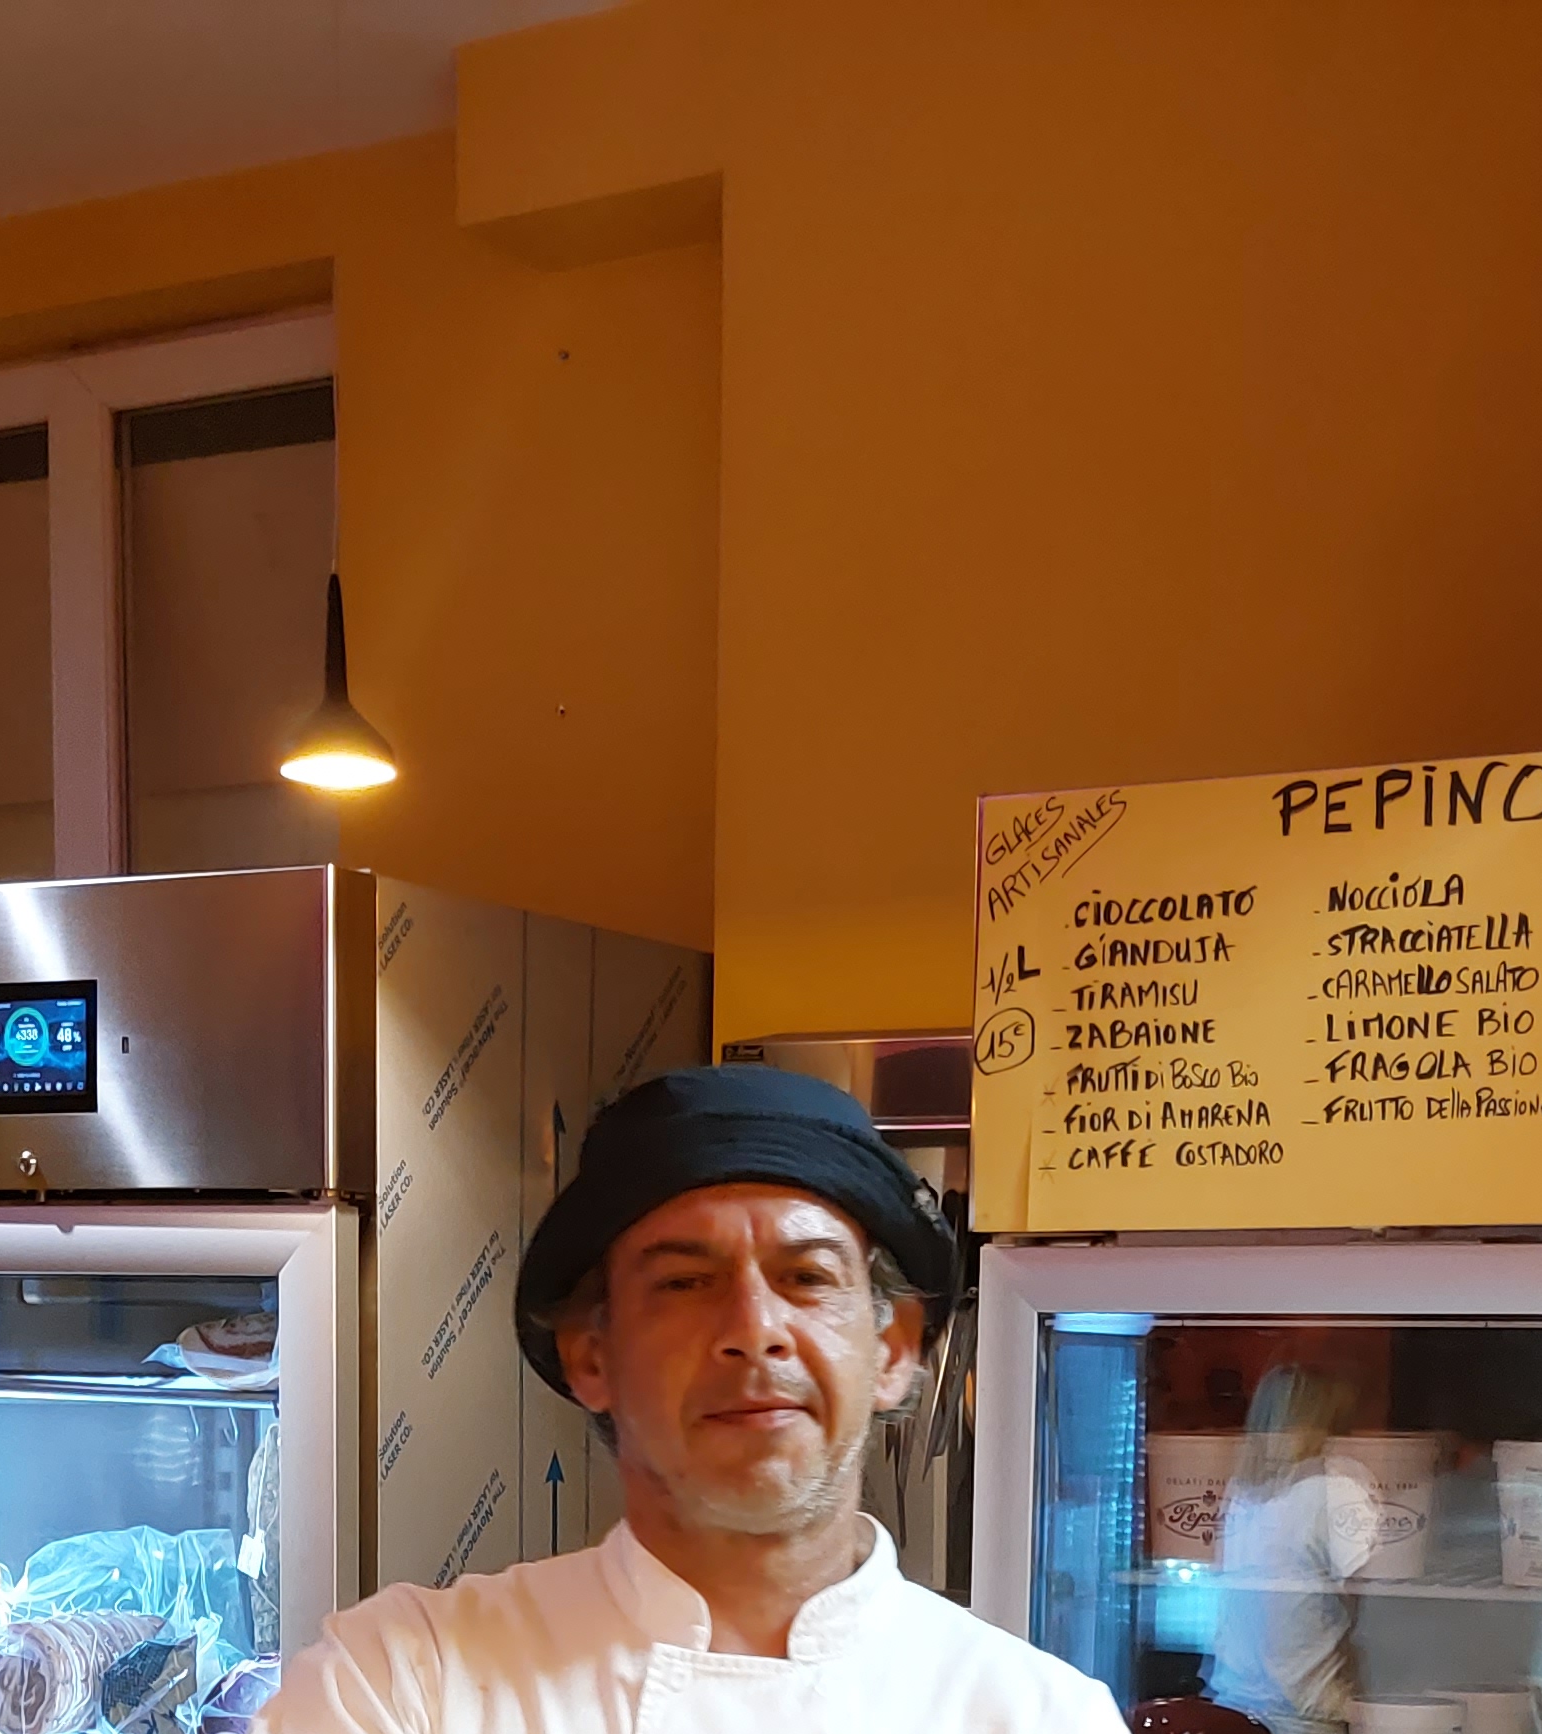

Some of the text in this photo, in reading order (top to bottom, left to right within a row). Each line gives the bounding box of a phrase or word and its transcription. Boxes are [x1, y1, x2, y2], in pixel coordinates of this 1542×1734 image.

[985, 796, 1064, 865] GLACES
[1018, 945, 1040, 980] L
[1455, 960, 1539, 994] SALATO
[1325, 1049, 1471, 1083] FRAGOLA
[1162, 1098, 1271, 1131] AMARENA
[1323, 1095, 1414, 1124] FRUTTO
[471, 1246, 491, 1278] LASER
[434, 1311, 455, 1348] LASER
[428, 1331, 458, 1380] Solution
[380, 1446, 402, 1482] LASER
[470, 1485, 491, 1521] LASER
[492, 1481, 507, 1505] The
